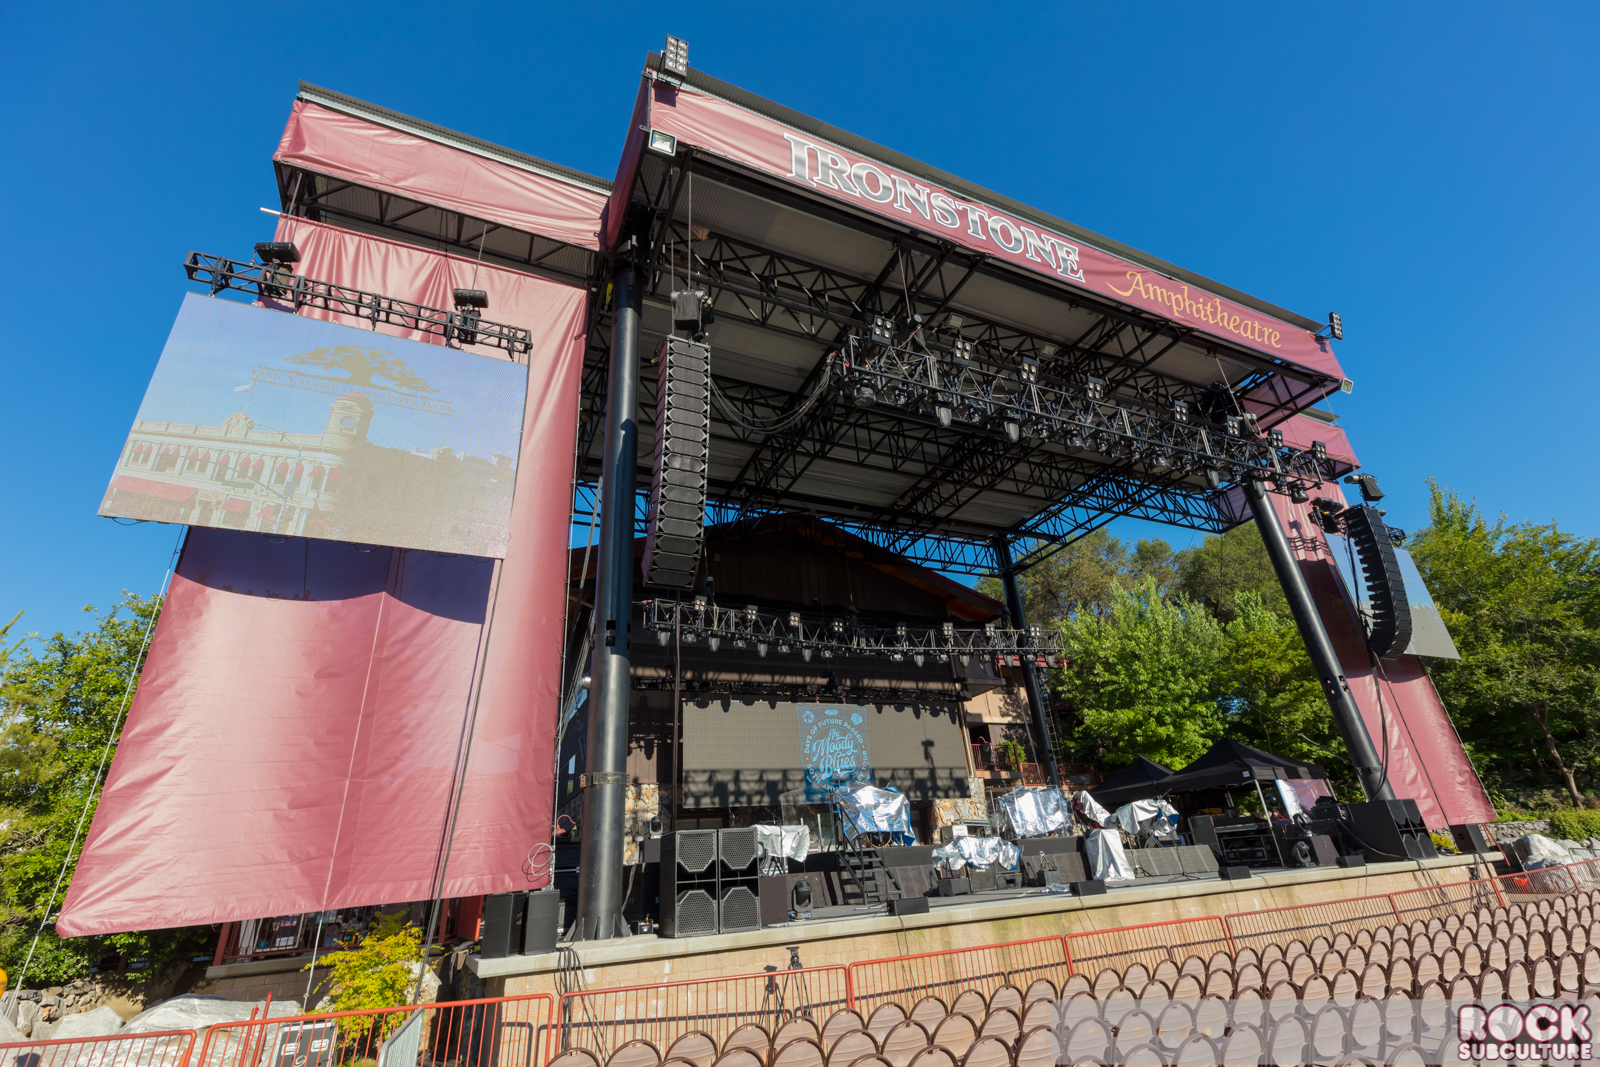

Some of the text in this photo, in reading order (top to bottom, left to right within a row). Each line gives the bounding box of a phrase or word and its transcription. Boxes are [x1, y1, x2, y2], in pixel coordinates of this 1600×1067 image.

[783, 132, 1282, 348] IRONSTONE Amphitheatre
[251, 369, 282, 381] OAK
[287, 375, 339, 390] VALLEY
[422, 400, 454, 412] BANK
[804, 718, 864, 753] DAYS OF FUTURE PASSED
[812, 733, 858, 762] Moody
[819, 751, 856, 780] Blues
